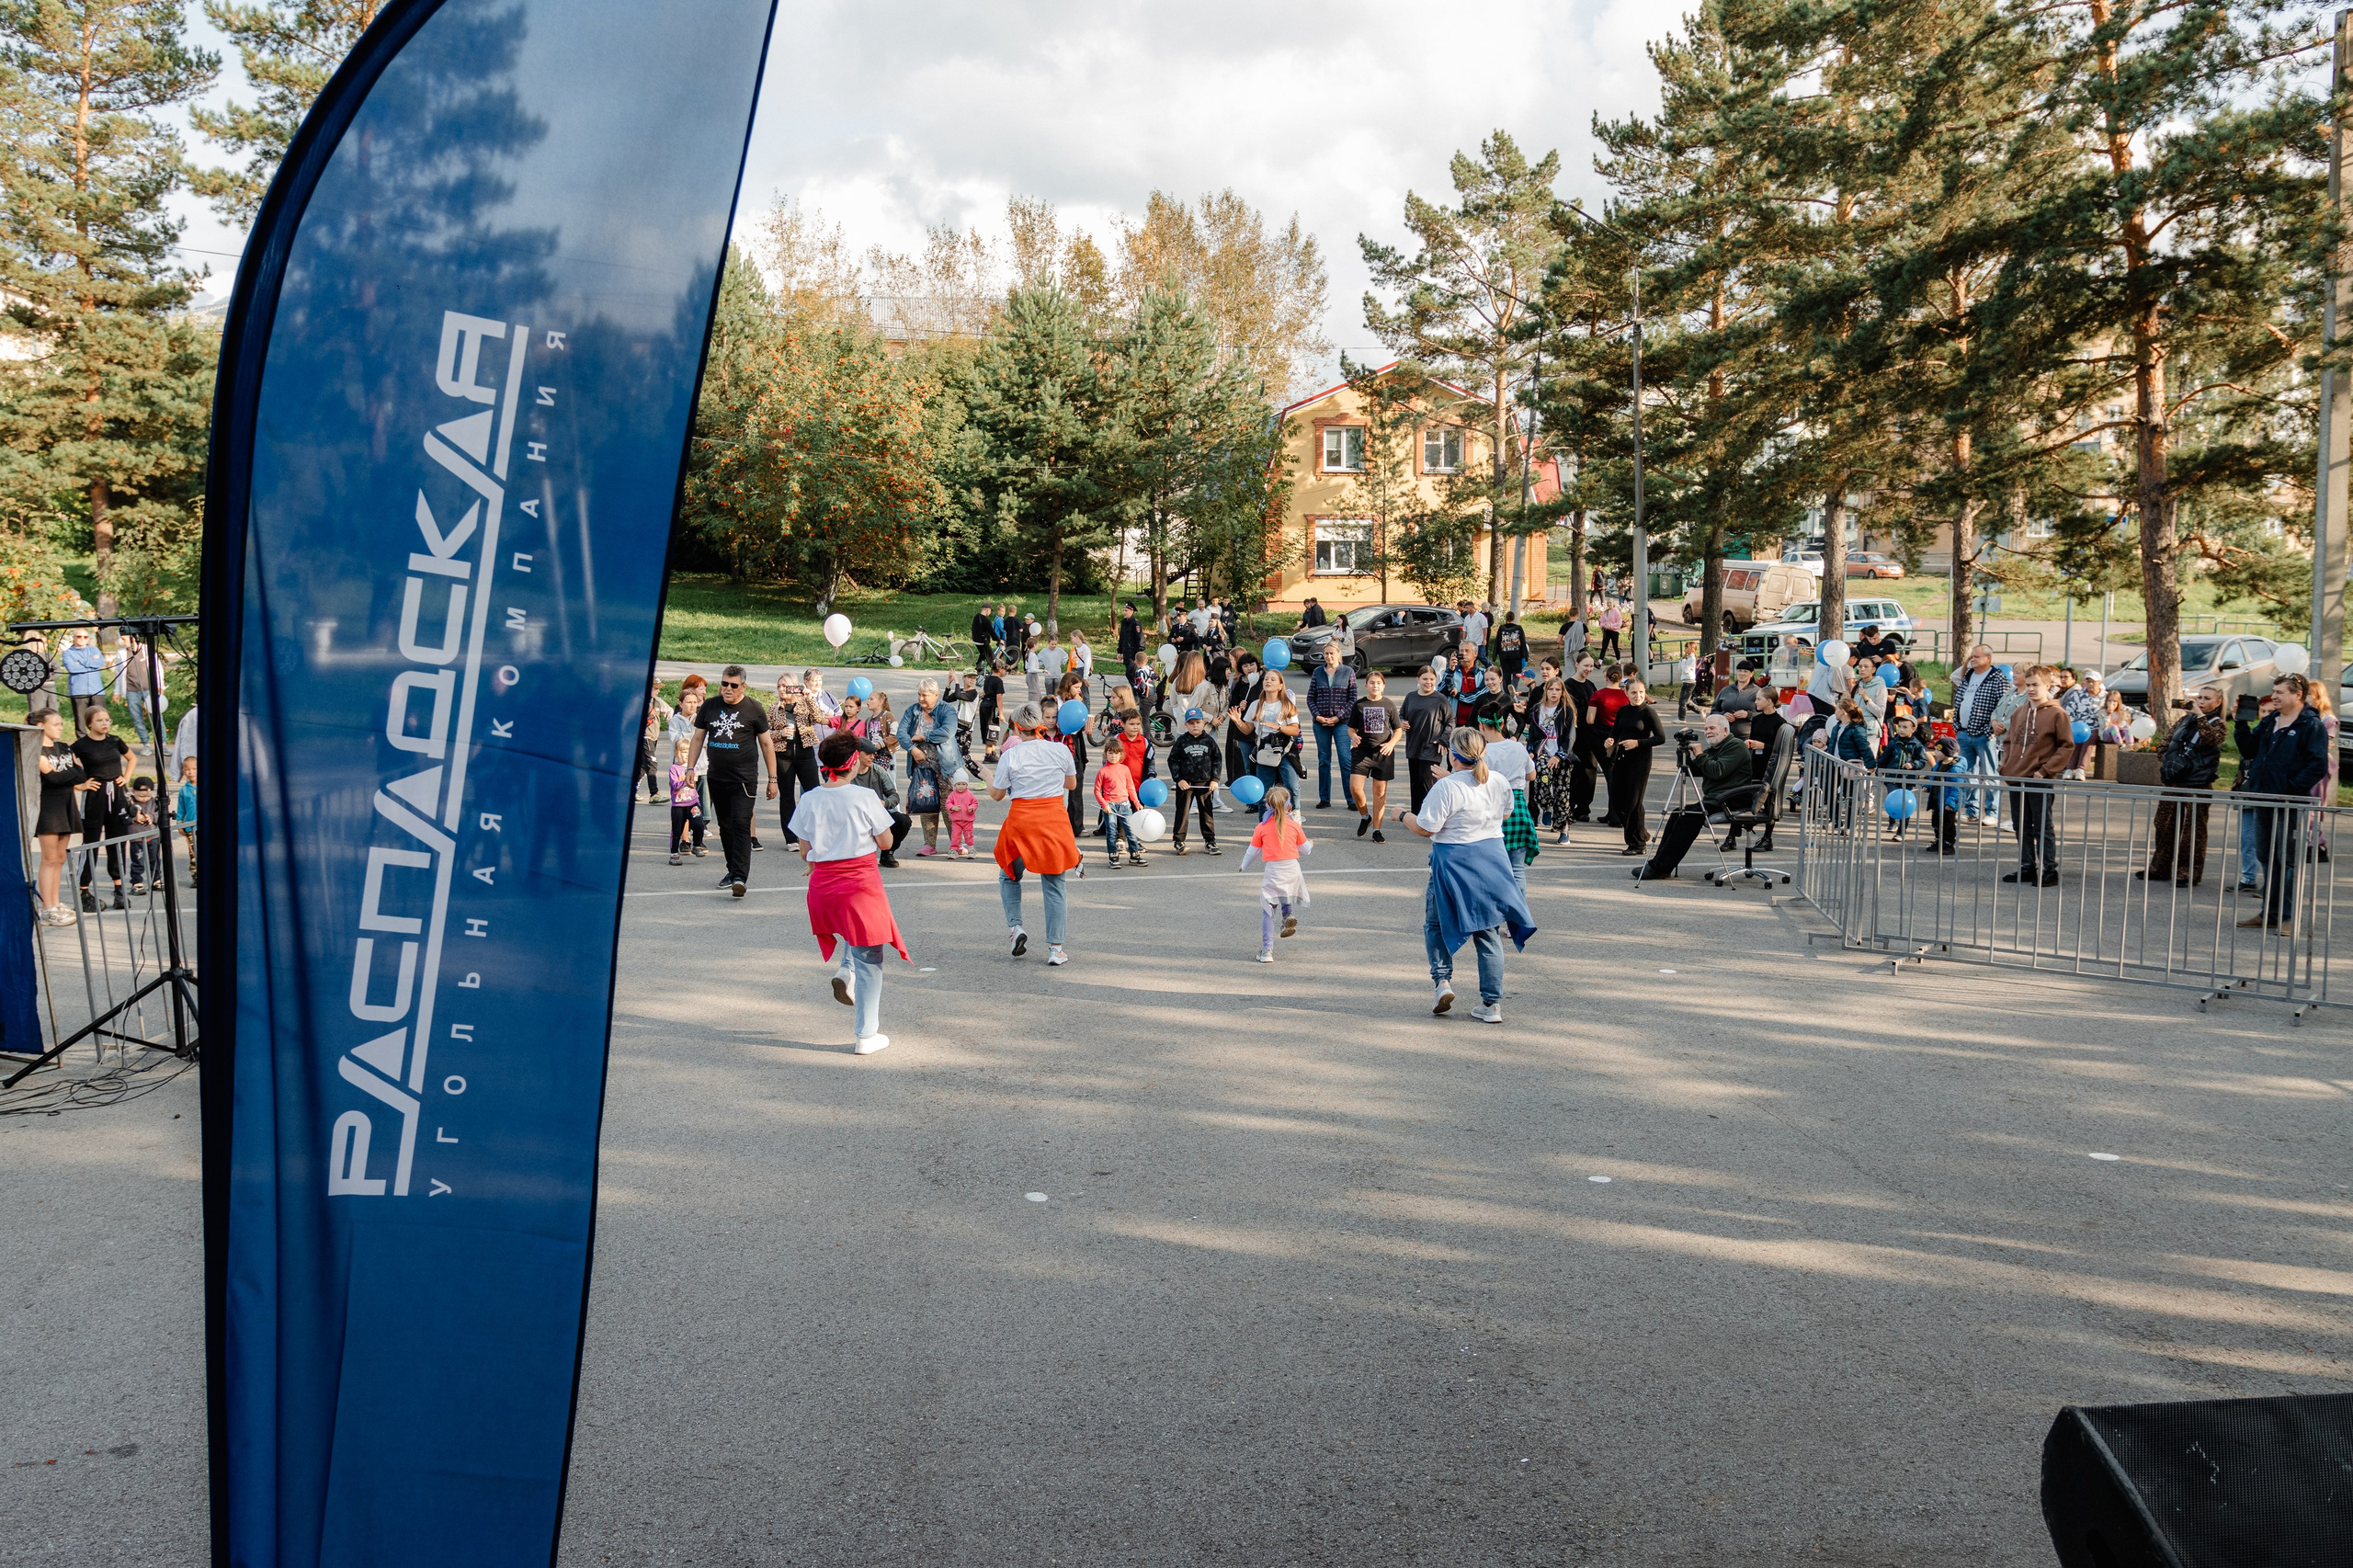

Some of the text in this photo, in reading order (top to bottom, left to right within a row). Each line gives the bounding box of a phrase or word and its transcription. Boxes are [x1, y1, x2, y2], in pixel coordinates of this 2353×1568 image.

[328, 311, 529, 1197] РАСПАДСКАЯ
[427, 330, 566, 1198] УГОЛЬНАЯ КОМПАНИЯ
